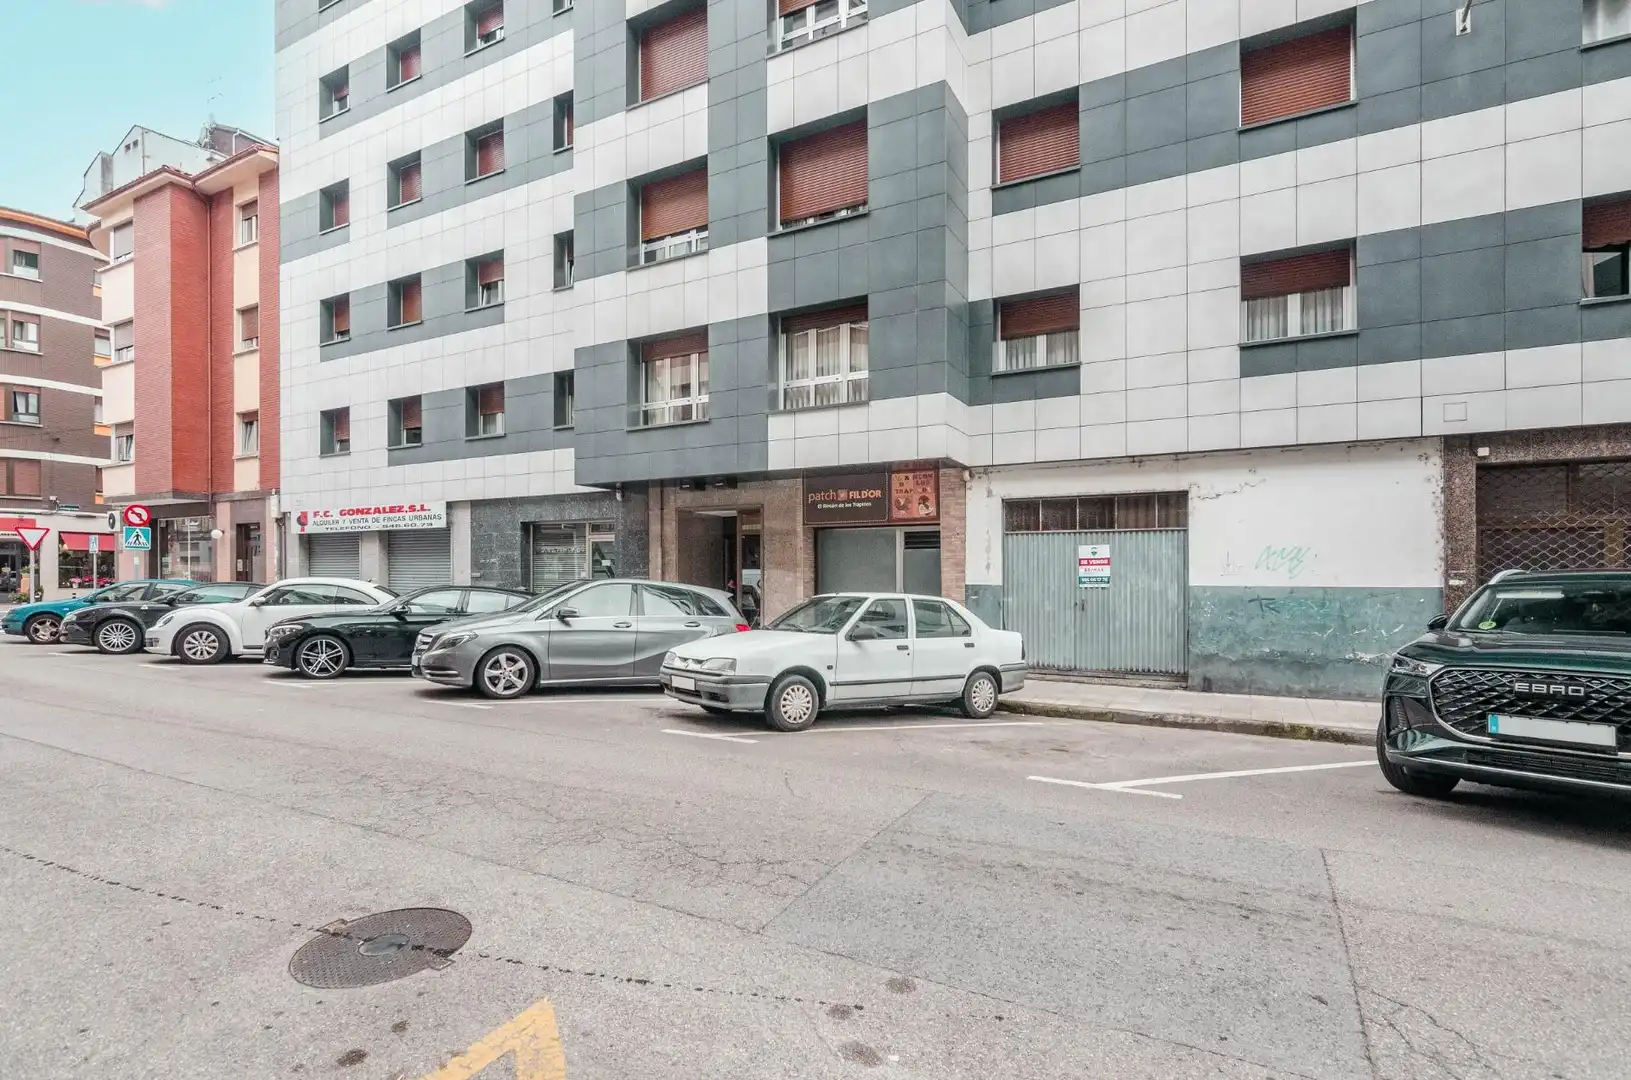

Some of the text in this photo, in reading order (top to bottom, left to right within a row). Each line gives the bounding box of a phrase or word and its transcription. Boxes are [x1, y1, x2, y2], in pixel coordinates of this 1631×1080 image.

[808, 489, 836, 504] patch
[313, 510, 333, 519] F.C.
[348, 517, 370, 525] VENTA
[371, 516, 381, 524] DE
[382, 515, 407, 523] FINCAS
[408, 513, 442, 521] URBANAS
[1515, 682, 1585, 696] EBRO
